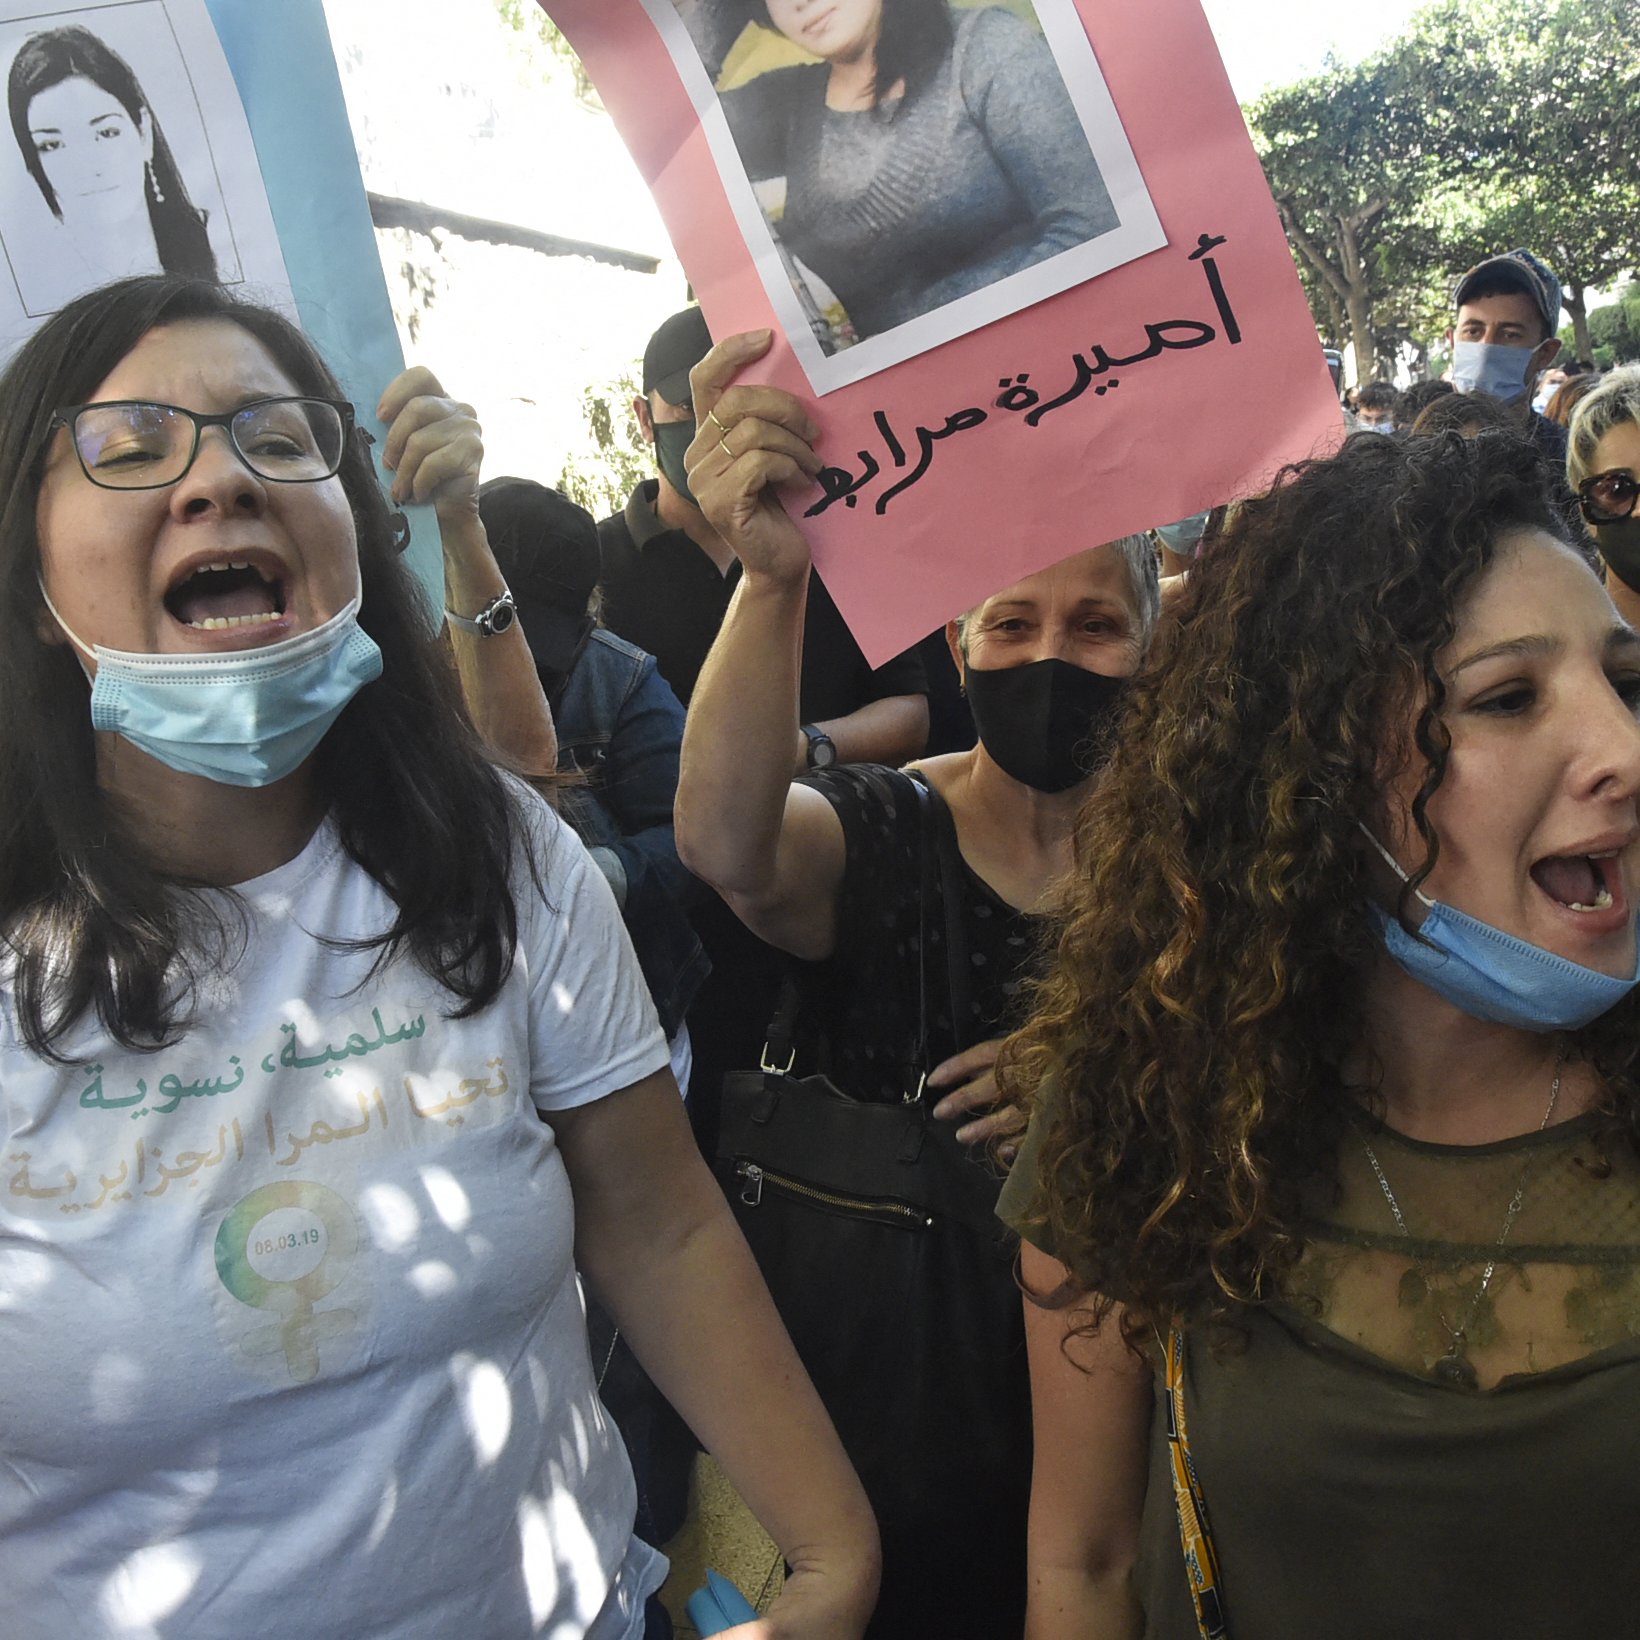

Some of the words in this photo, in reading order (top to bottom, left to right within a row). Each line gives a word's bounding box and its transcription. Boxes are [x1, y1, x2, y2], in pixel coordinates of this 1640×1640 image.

[261, 1006, 427, 1079] سلمية،
[79, 1055, 245, 1120] نسوية
[404, 1056, 509, 1127] تحيا
[264, 1086, 389, 1166] المرا
[9, 1117, 245, 1214] الجزايرية
[255, 1228, 319, 1255] 08.03.19
